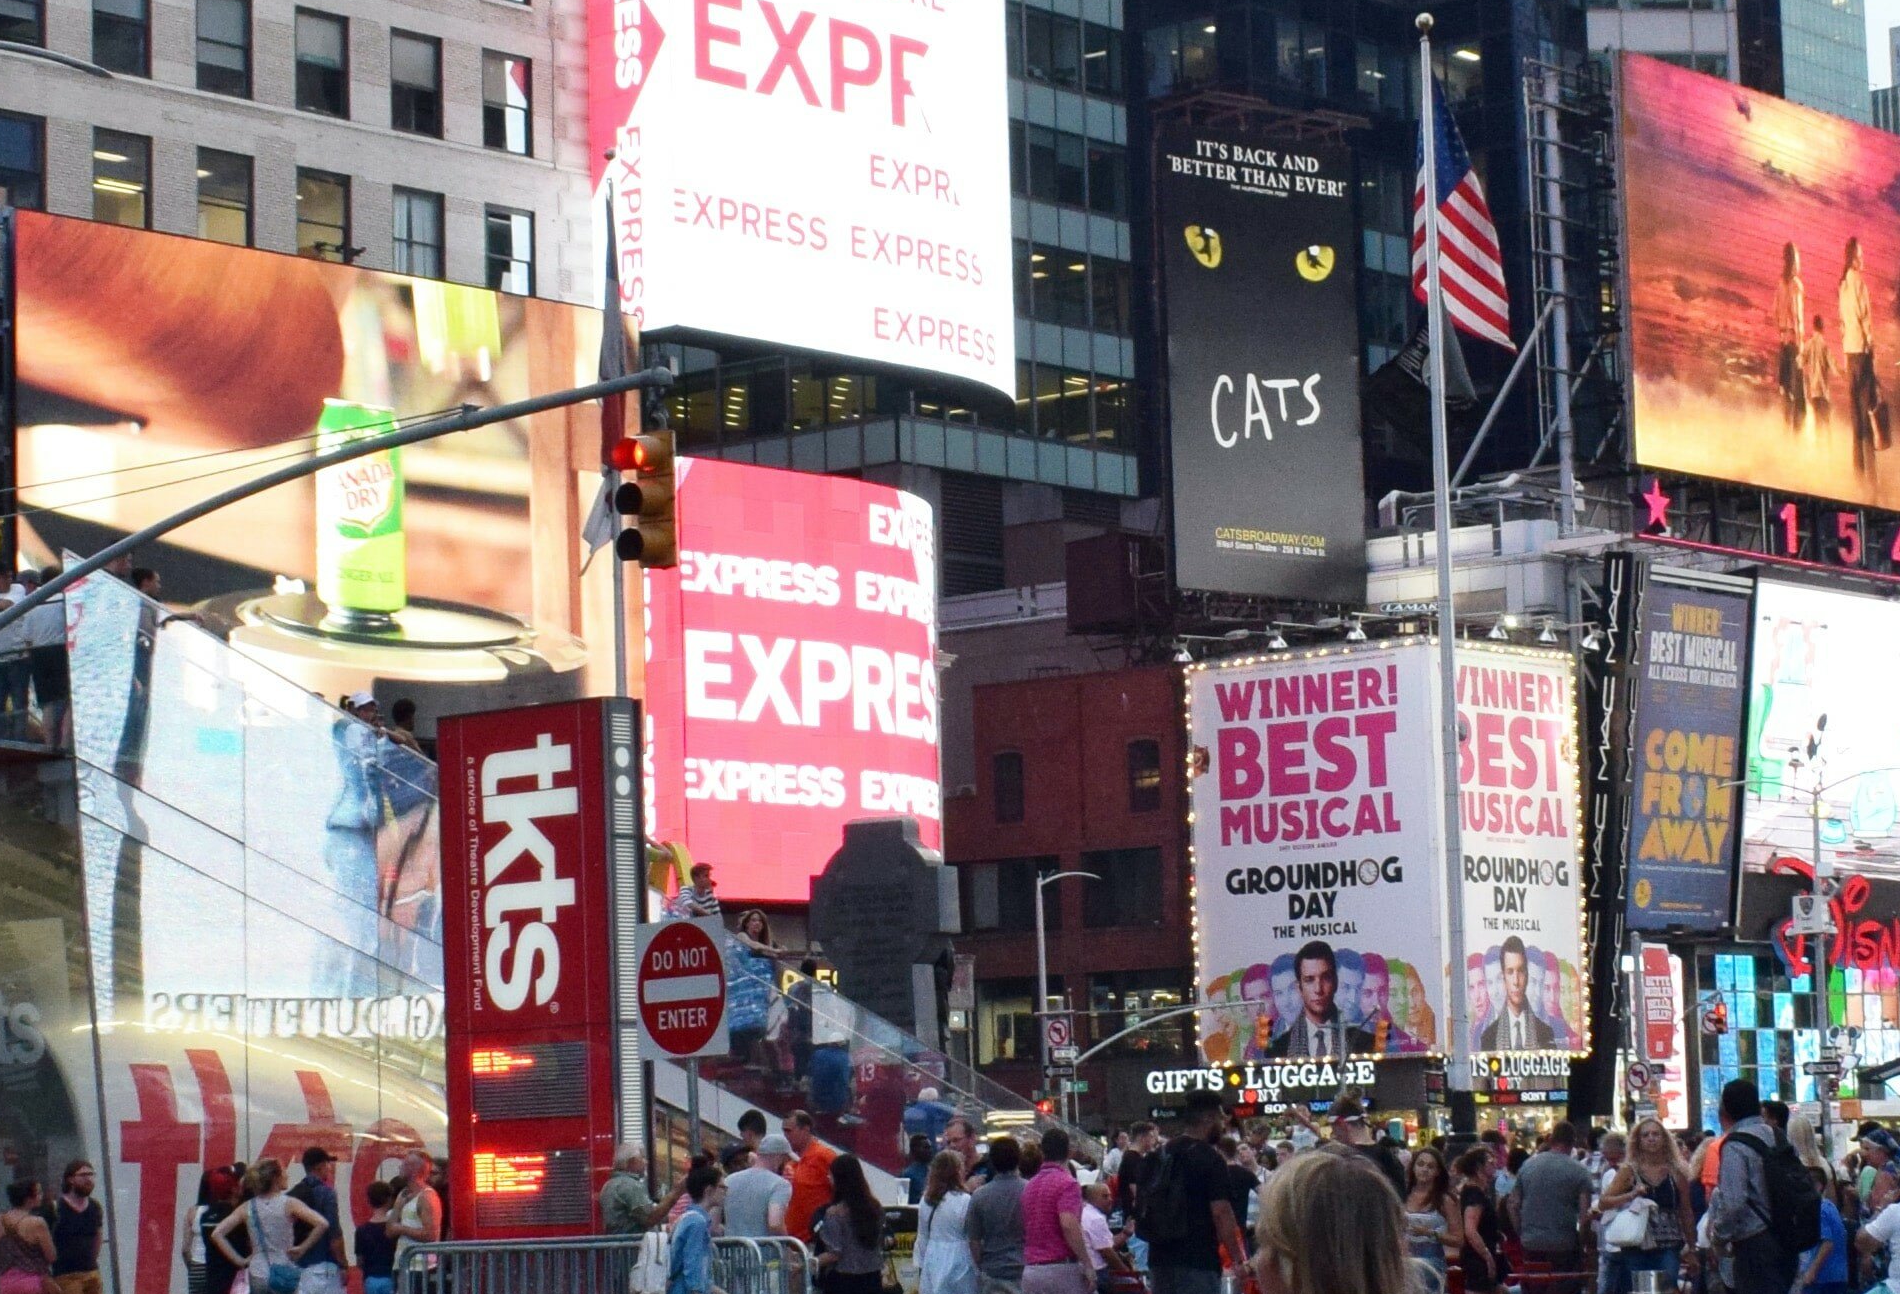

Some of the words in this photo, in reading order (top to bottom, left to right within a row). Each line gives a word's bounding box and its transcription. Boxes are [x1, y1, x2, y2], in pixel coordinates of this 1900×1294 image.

[1196, 140, 1228, 160] IT'S
[1233, 146, 1278, 168] BACK
[1282, 154, 1319, 173] AND
[1241, 168, 1290, 190] THAN
[673, 187, 828, 251] EXPRESS
[850, 225, 983, 287] EXPRESS
[873, 307, 996, 365] EXPRESS
[1210, 372, 1322, 449] CATS
[679, 550, 840, 607] EXPRESS
[1651, 630, 1682, 663] BEST
[1684, 634, 1737, 672] MUSICAL
[1215, 665, 1398, 722] WINNER!
[1218, 711, 1397, 800] BEST
[1645, 727, 1734, 777] COME
[467, 767, 477, 815] service
[684, 757, 846, 810] EXPRESS
[1220, 791, 1401, 846] MUSICAL
[470, 835, 479, 885] Theatre
[1638, 818, 1729, 865] AWAY
[481, 733, 578, 1011] tkts
[1226, 856, 1403, 895] GROUNDHOG
[1288, 891, 1338, 920] DAY
[1494, 887, 1526, 914] DAY
[471, 889, 482, 989] Development
[1272, 924, 1298, 939] THE
[1301, 921, 1358, 938] MUSICAL
[1483, 916, 1498, 931] THE
[1503, 917, 1540, 932] MUSICAL
[652, 949, 674, 971] DO
[678, 946, 709, 969] NOT
[473, 992, 482, 1011] Fund
[658, 1006, 707, 1031] ENTER
[1146, 1069, 1224, 1093] GIFTS
[1245, 1061, 1375, 1089] LUGGAGE
[1499, 1057, 1570, 1077] LUGGAGE
[1521, 1092, 1546, 1101] SONY
